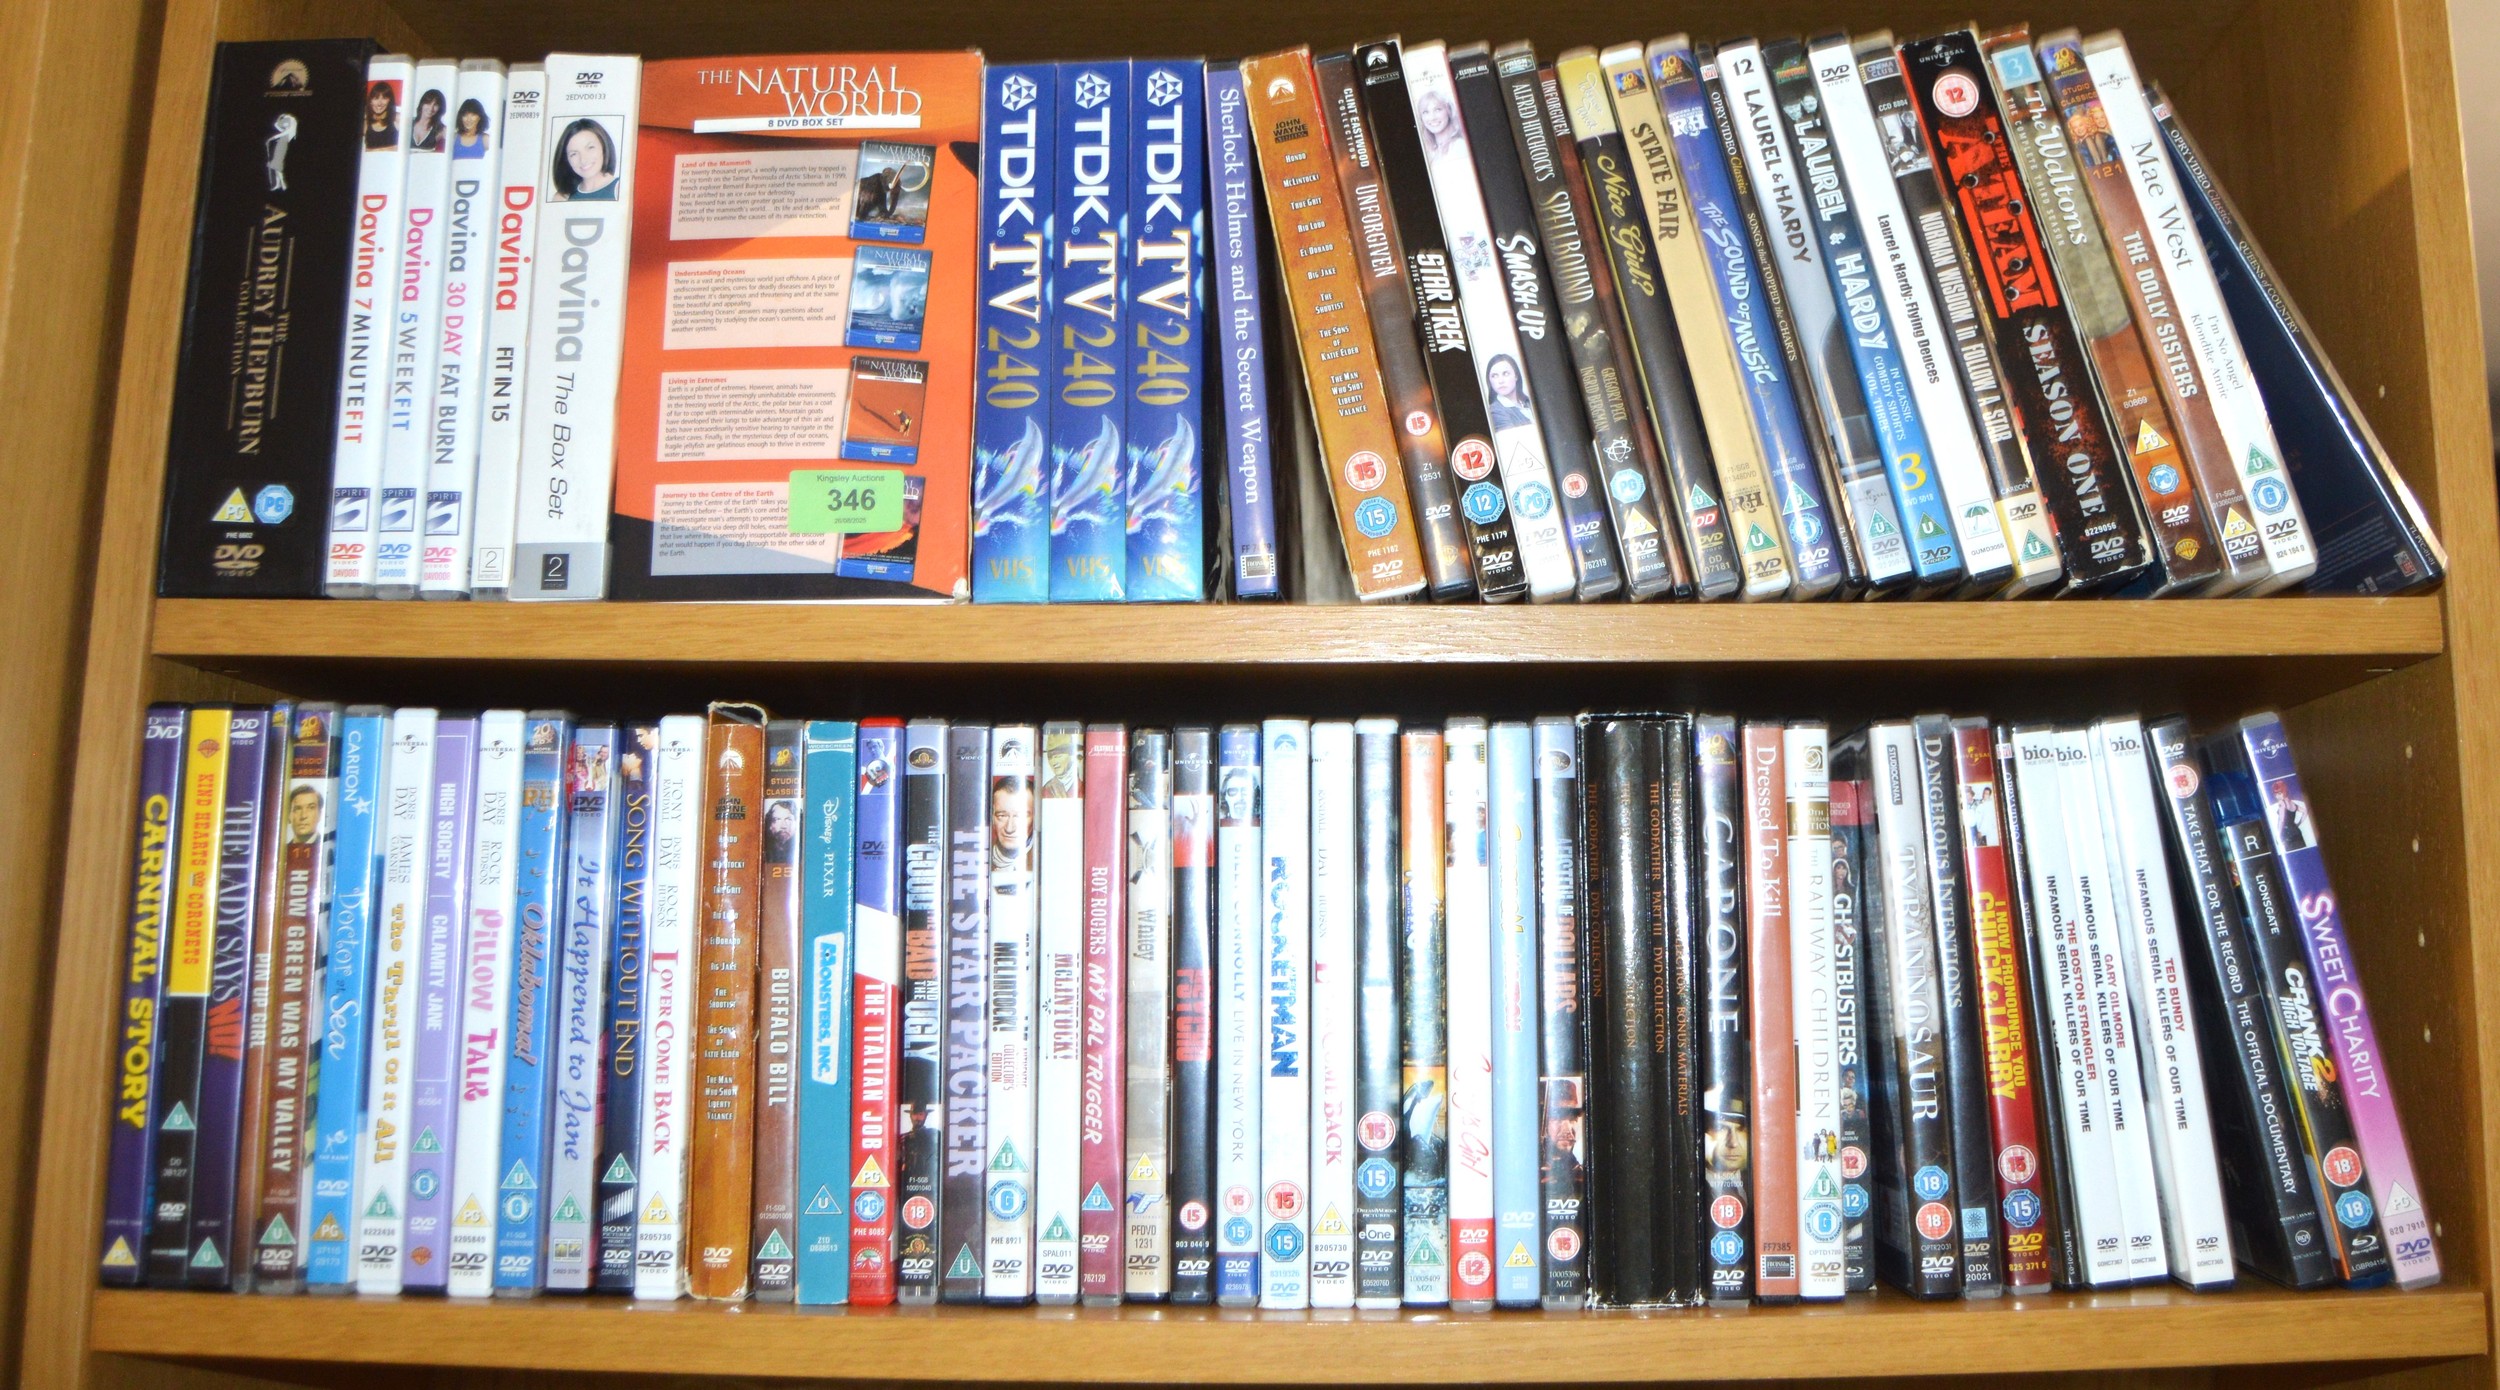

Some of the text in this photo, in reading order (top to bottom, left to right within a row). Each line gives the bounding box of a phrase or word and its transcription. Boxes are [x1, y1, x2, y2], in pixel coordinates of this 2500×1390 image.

[698, 65, 905, 95] THE NATURAL
[776, 119, 799, 127] DVD
[824, 118, 844, 126] SET
[784, 90, 922, 117] WORLD
[1338, 100, 1357, 160] COLLECTION
[1343, 88, 1370, 167] CLINT EASTWOOD
[1512, 84, 1555, 181] ALFRED HITCHCOCK'S
[1631, 124, 1679, 240] STATE FAIR
[1711, 92, 1797, 361] OPRY VIDEO Classics SONGS that TOPPED the CHARTS
[1744, 90, 1811, 264] LAUREL & HARDY
[2130, 140, 2193, 271] Mae West
[987, 107, 1042, 408] TDK TV 240
[1320, 267, 1336, 277] JAKE
[1356, 184, 1396, 278] UNFORGIVEN
[1543, 191, 1593, 303] SPELLBOUND
[1919, 211, 1953, 265] NORMAN
[230, 280, 251, 375] COLLECTION
[237, 204, 288, 454] AUDREY HEPBURN
[275, 312, 291, 343] THE
[435, 180, 480, 465] Davina 30 DAY FAT BURN
[492, 185, 534, 422] Davina FIT IN 15
[1219, 89, 1263, 505] Sherlock Holmes and the Secret Weapon
[1413, 286, 1427, 317] SPECIAL
[1420, 321, 1436, 353] EDITION
[1417, 254, 1465, 353] STAR TREK
[1496, 236, 1544, 339] SMASH-UP
[1877, 214, 1940, 384] Laurel & Hardy: Flying Deuces
[1934, 269, 1973, 319] WISDOM
[2123, 231, 2198, 397] THE DOLLY SISTERS
[548, 218, 604, 520] Davina The Box Set
[1960, 343, 1994, 391] FOLLOW
[1977, 395, 1995, 406] A
[816, 475, 848, 483] Kingsley
[1982, 410, 2012, 443] STAR
[427, 492, 460, 501] SPIRIT
[828, 489, 875, 512] 346
[344, 730, 362, 801] CARLTON
[1887, 747, 1901, 803] STUDIOCANAL
[823, 854, 835, 897] PIXAR
[1757, 746, 1781, 917] Dressed To Kill
[427, 783, 455, 1031] HIGH SOCIETY CALAMITY JANE
[614, 794, 650, 1076] SONG WITHOUT END
[2255, 874, 2280, 935] LIONSGATE
[122, 795, 169, 1128] CARNIVAL STORY
[562, 855, 599, 1162] It Happened to Jane
[816, 942, 838, 1078] MONSTERS, INC.
[949, 825, 987, 1177] THE STAR PACKER
[1083, 866, 1106, 1144] ROY ROGERS MY PAL TRIGGER
[2136, 869, 2187, 1129] INFAMOUS SERIAL KILLERS OF OUR TIME
[2164, 958, 2184, 1032] TED BUNDY
[2183, 804, 2297, 1194] TAKE THAT FOR THE RECORD THE OFFICIAL DOCUMENTARY
[2301, 895, 2380, 1099] SWEET CHARITY
[271, 870, 308, 1172] HOW GREEN WAS MY VALLEY
[464, 1028, 498, 1101] TALK
[768, 968, 790, 1106] BUFFALO BILL
[863, 983, 885, 1148] THE ITALIAN JOB
